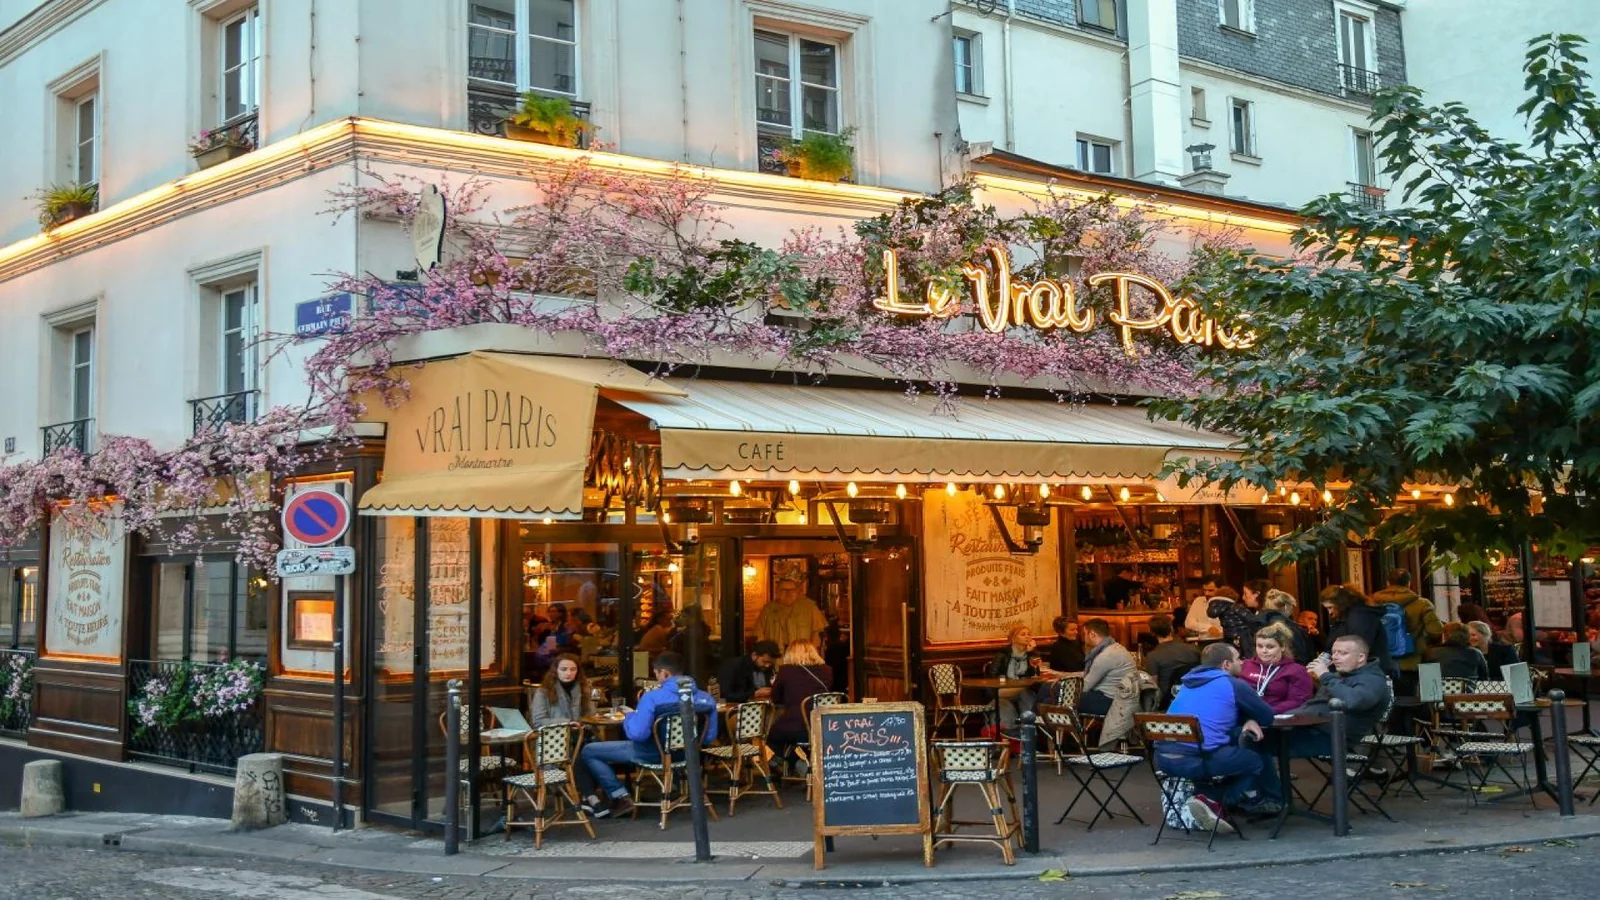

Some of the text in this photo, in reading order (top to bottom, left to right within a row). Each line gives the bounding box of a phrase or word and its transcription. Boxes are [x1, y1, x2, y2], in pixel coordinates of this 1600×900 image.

[873, 248, 960, 318] Le
[963, 246, 1096, 333] Vrai
[316, 304, 332, 315] RUE
[416, 388, 558, 453] VRAI PARIS
[738, 440, 785, 461] CAFÉ
[447, 455, 514, 472] Montmartre
[965, 563, 1026, 580] PRODUITS FRAIS
[966, 585, 1026, 604] FAIT MAISON
[963, 603, 1002, 619] TOUTE
[1004, 596, 1040, 618] HEURE
[828, 719, 839, 731] LE
